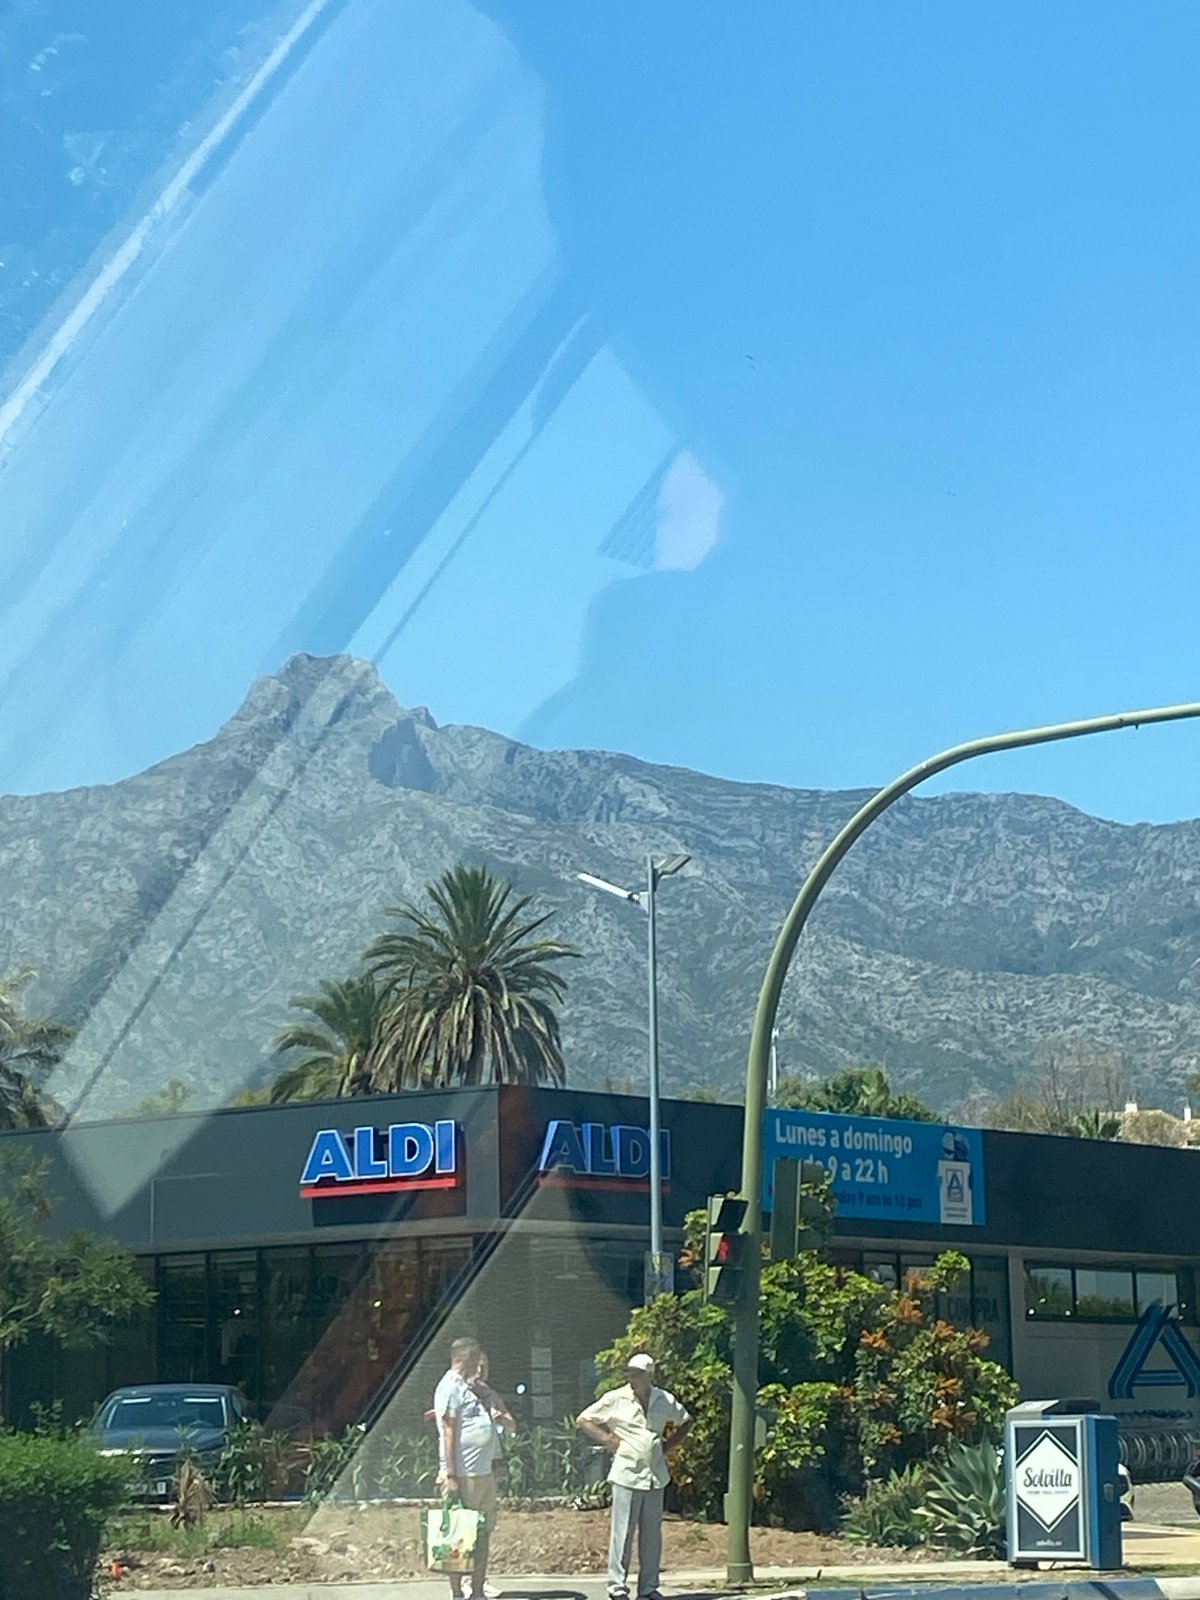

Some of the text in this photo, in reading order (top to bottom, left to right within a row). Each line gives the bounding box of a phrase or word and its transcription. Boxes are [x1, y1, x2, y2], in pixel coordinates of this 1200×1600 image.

[300, 1120, 455, 1184] ALDI
[539, 1120, 671, 1179] ALDI
[775, 1118, 912, 1158] Lunes a domingo
[827, 1155, 838, 1181] 9
[842, 1162, 851, 1181] a
[1023, 1467, 1072, 1488] Solvilla
